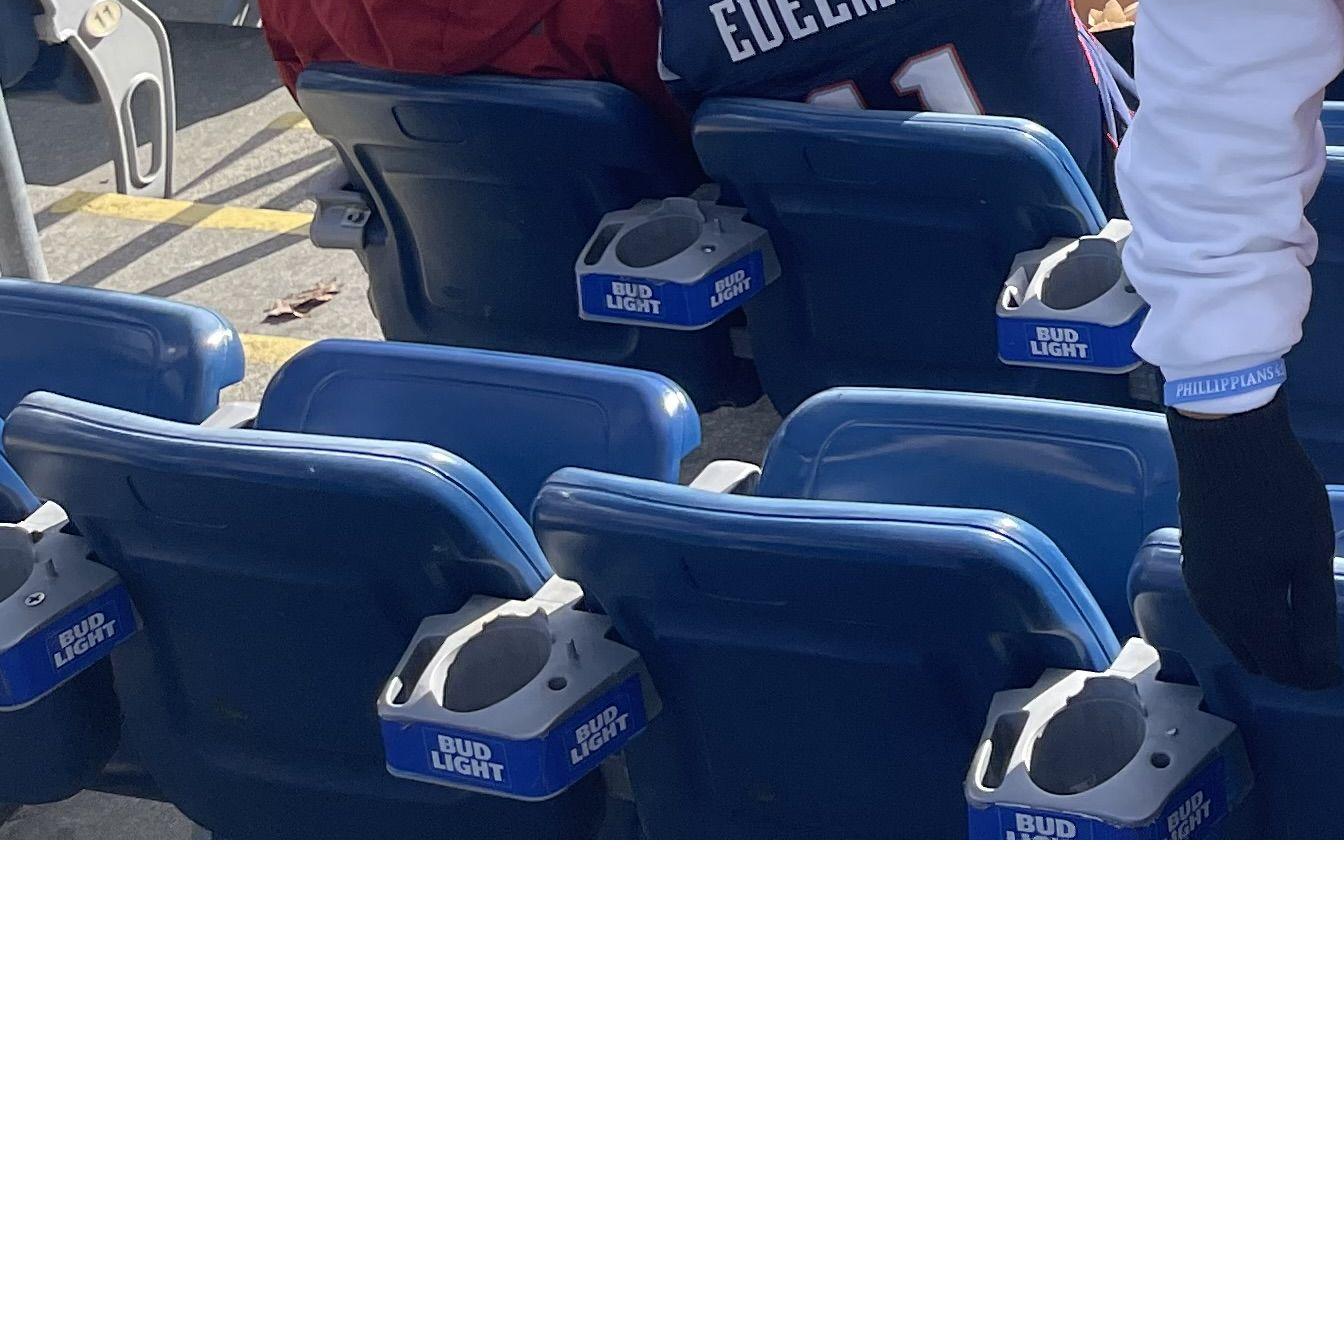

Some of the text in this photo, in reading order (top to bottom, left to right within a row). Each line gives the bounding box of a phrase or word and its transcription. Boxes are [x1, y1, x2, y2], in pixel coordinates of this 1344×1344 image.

[612, 280, 654, 299] BUD
[710, 277, 752, 309] LIGHT
[714, 269, 746, 293] BUD
[606, 293, 662, 315] LIGHT
[1030, 339, 1088, 359] LIGHT
[1036, 326, 1079, 343] BUD
[1175, 366, 1274, 398] PHILLIPPIANS
[58, 611, 105, 649] BUD
[53, 622, 116, 670] LIGHT
[574, 702, 620, 747] BUD
[437, 733, 493, 764] BUD
[569, 718, 630, 767] LIGHT
[430, 753, 506, 784] LIGHT
[1015, 812, 1077, 839] BUD
[1166, 790, 1204, 831] BUD
